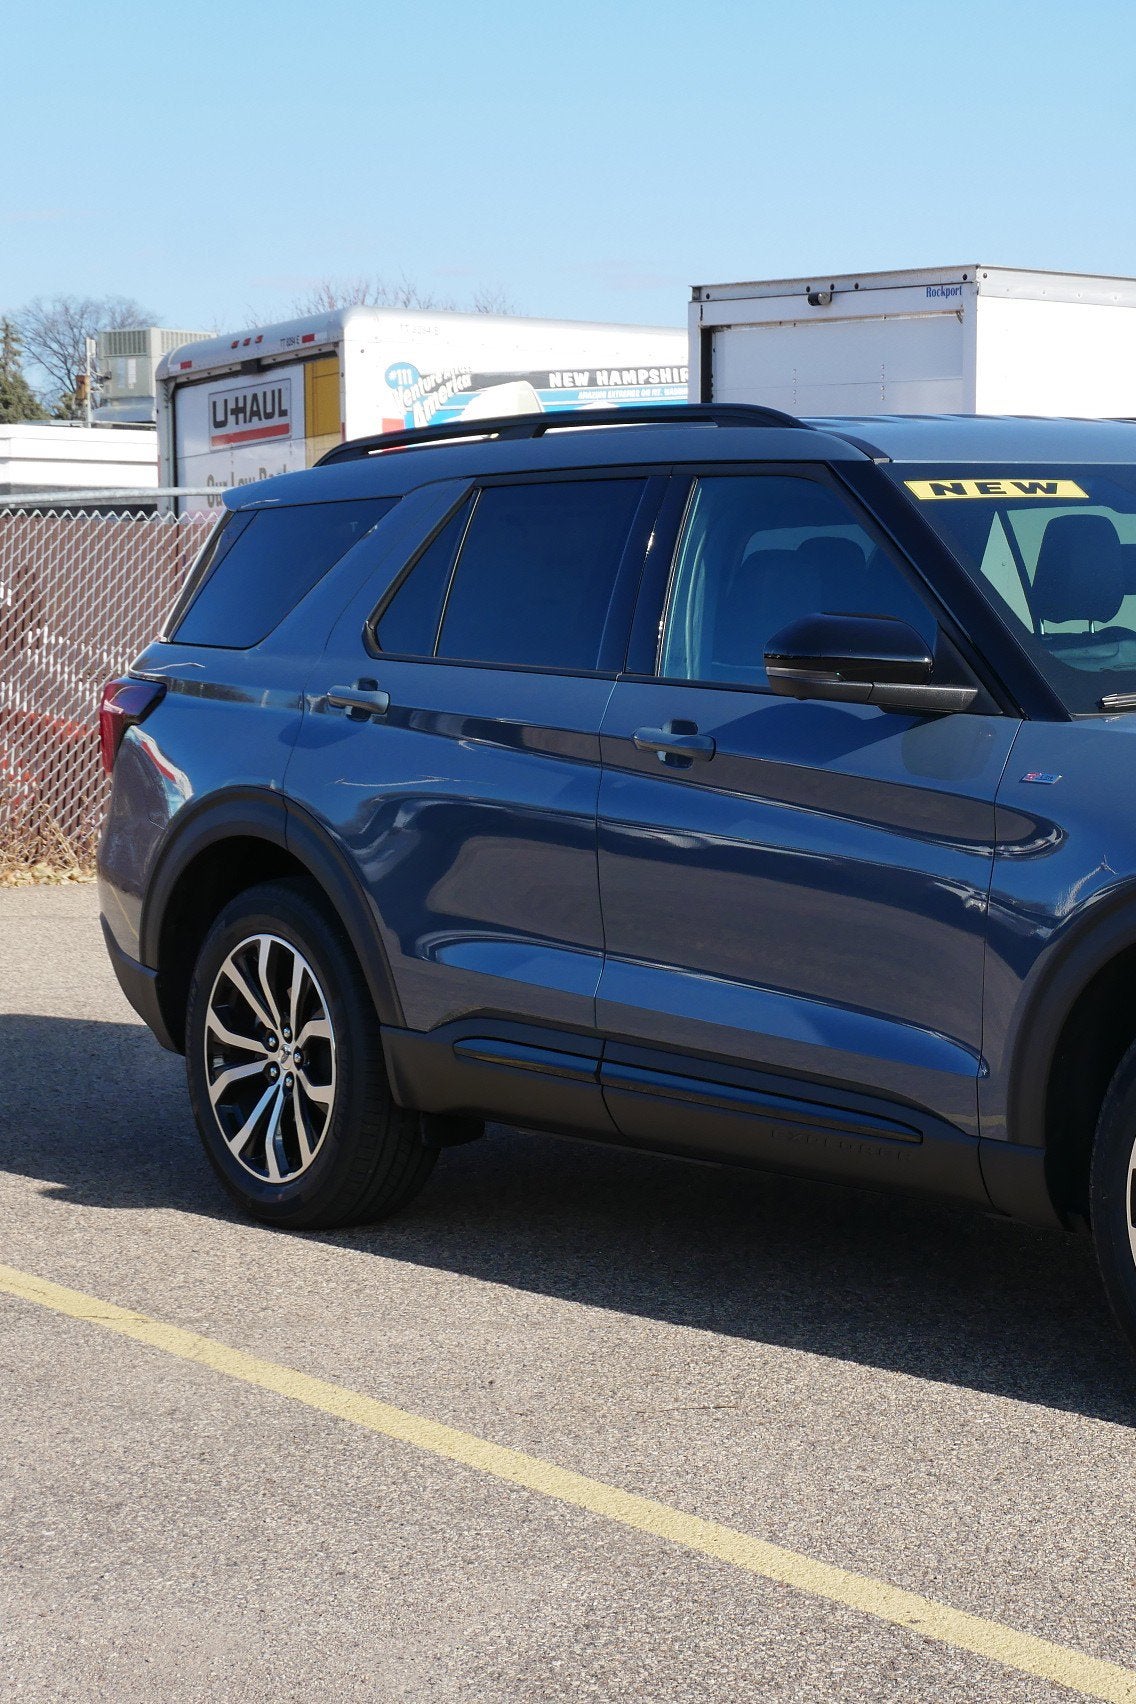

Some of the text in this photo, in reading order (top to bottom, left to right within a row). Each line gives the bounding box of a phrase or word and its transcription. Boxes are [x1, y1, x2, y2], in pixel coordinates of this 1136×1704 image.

[926, 285, 962, 299] Rockport
[549, 367, 689, 388] NEW HAMPSHIR
[211, 388, 288, 429] U-HAUL
[928, 481, 1058, 496] NEW
